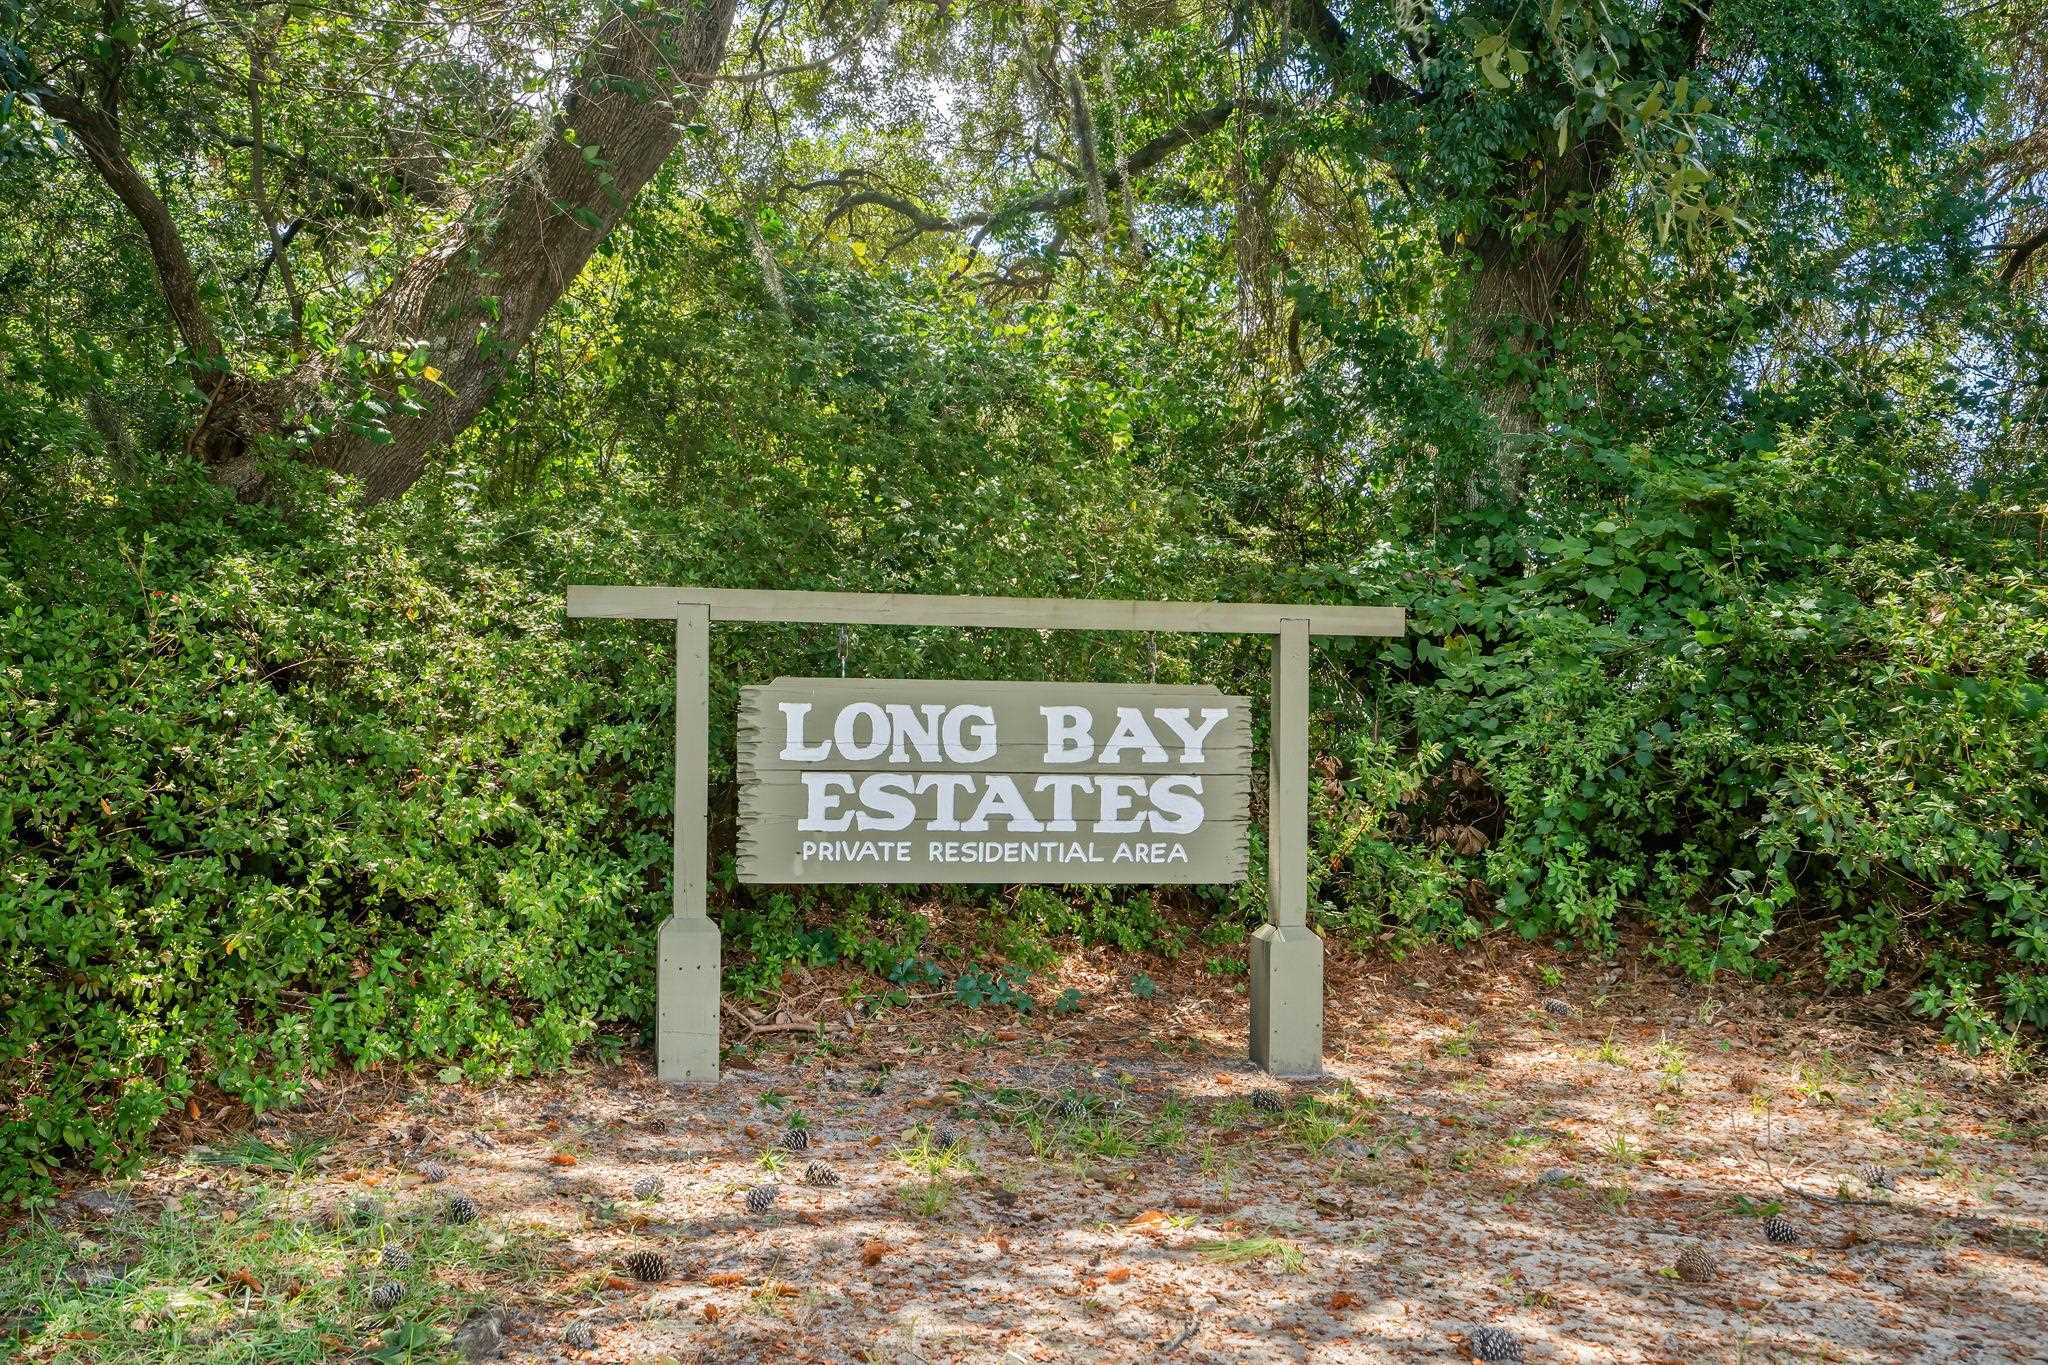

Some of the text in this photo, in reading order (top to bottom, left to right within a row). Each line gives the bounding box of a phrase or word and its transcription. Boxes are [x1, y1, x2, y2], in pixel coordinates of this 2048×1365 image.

[778, 701, 1229, 764] LONG BAY
[797, 772, 1206, 835] ESTATES
[802, 840, 1188, 864] PRIVATE RESIDENTIAL AREA
